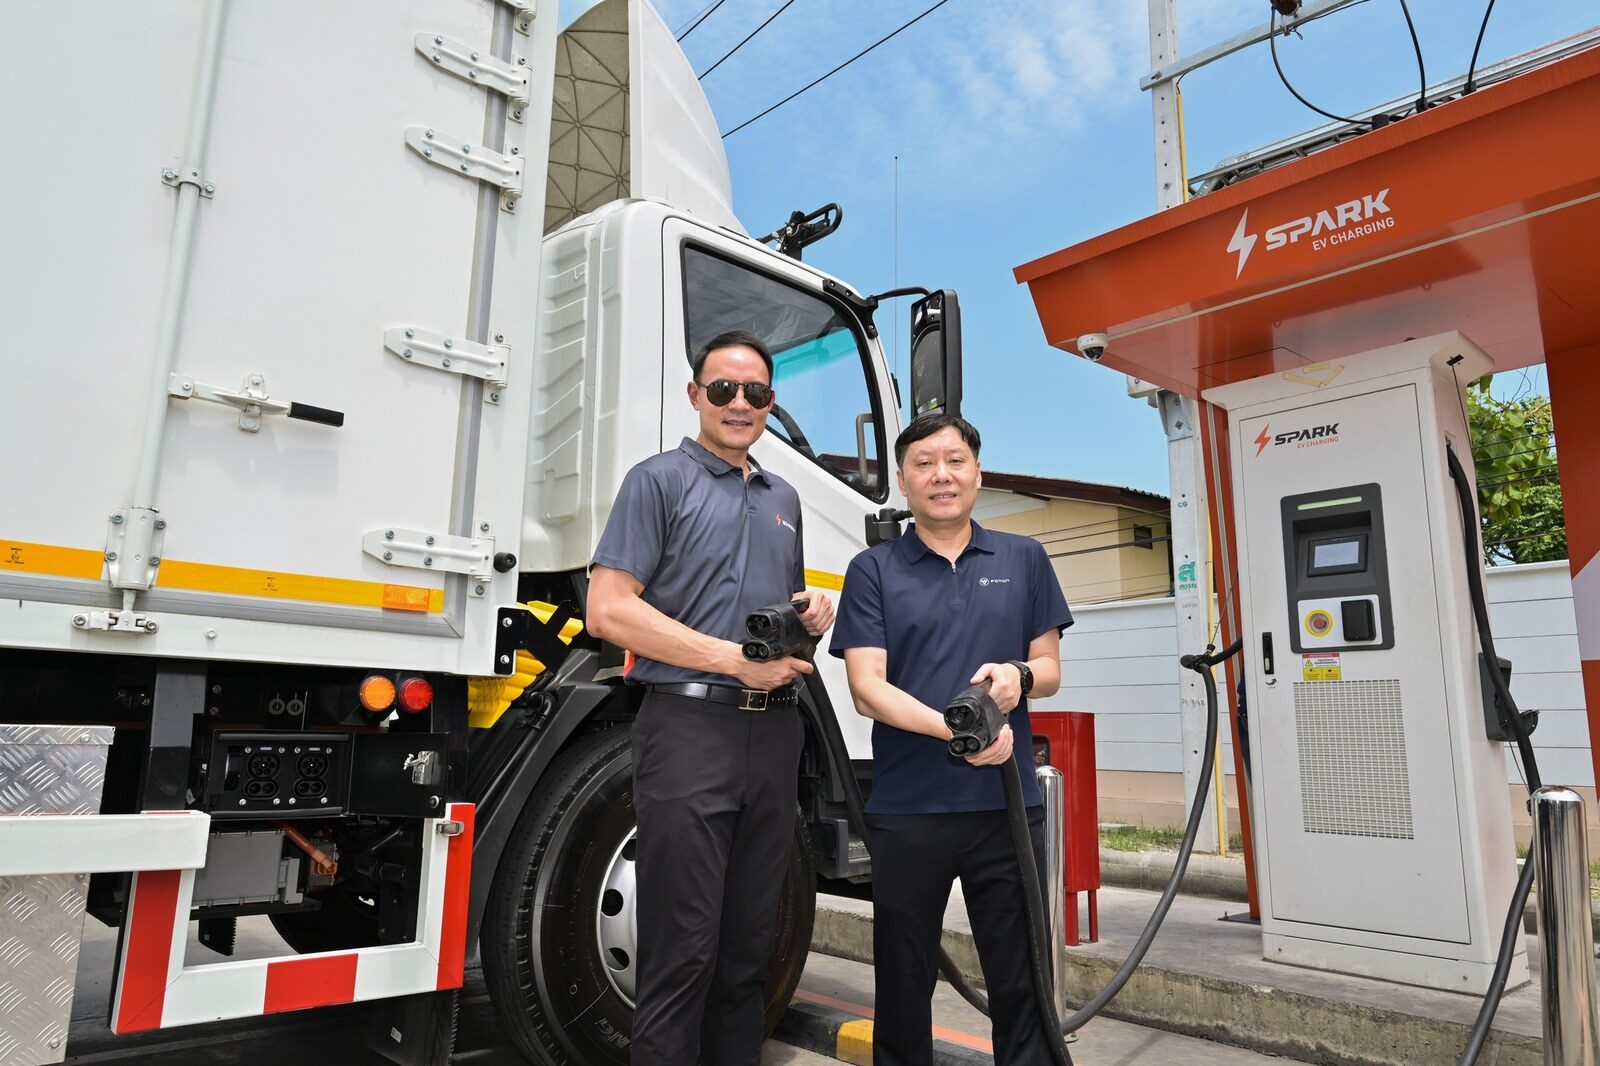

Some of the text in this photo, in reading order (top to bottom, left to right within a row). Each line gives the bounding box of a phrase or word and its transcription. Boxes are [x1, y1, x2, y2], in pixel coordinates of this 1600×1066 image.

[1265, 188, 1391, 251] SPARK
[1312, 217, 1395, 251] EV CHARGING
[1274, 423, 1339, 446] SPARK
[1306, 437, 1339, 448] CHARGING
